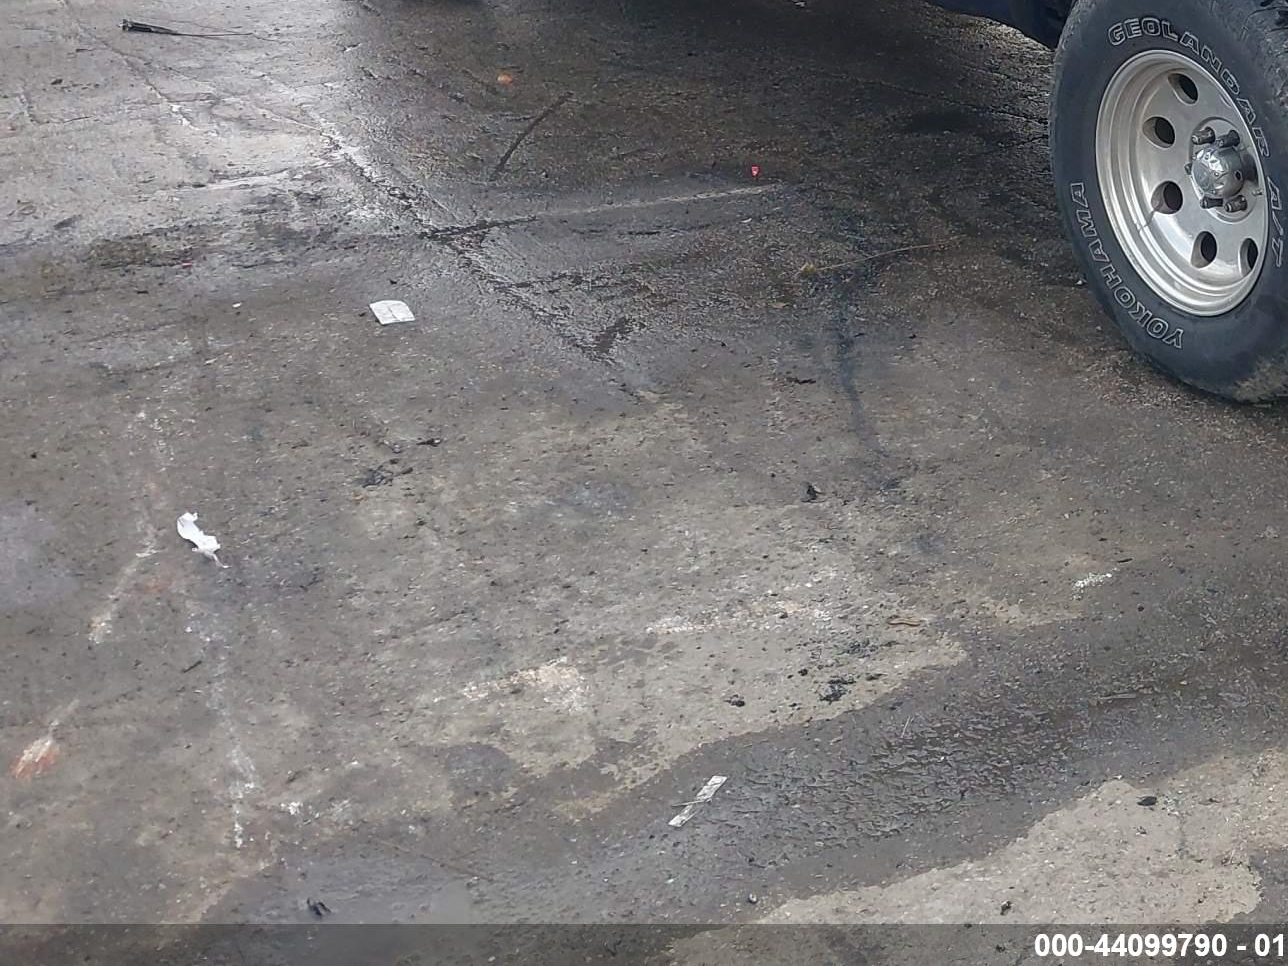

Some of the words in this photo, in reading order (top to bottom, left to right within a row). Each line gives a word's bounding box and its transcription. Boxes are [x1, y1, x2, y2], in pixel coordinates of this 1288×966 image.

[1107, 16, 1271, 158] GEOLANDAR
[1069, 181, 1184, 350] YOKOHAMA
[1266, 175, 1284, 268] A/T
